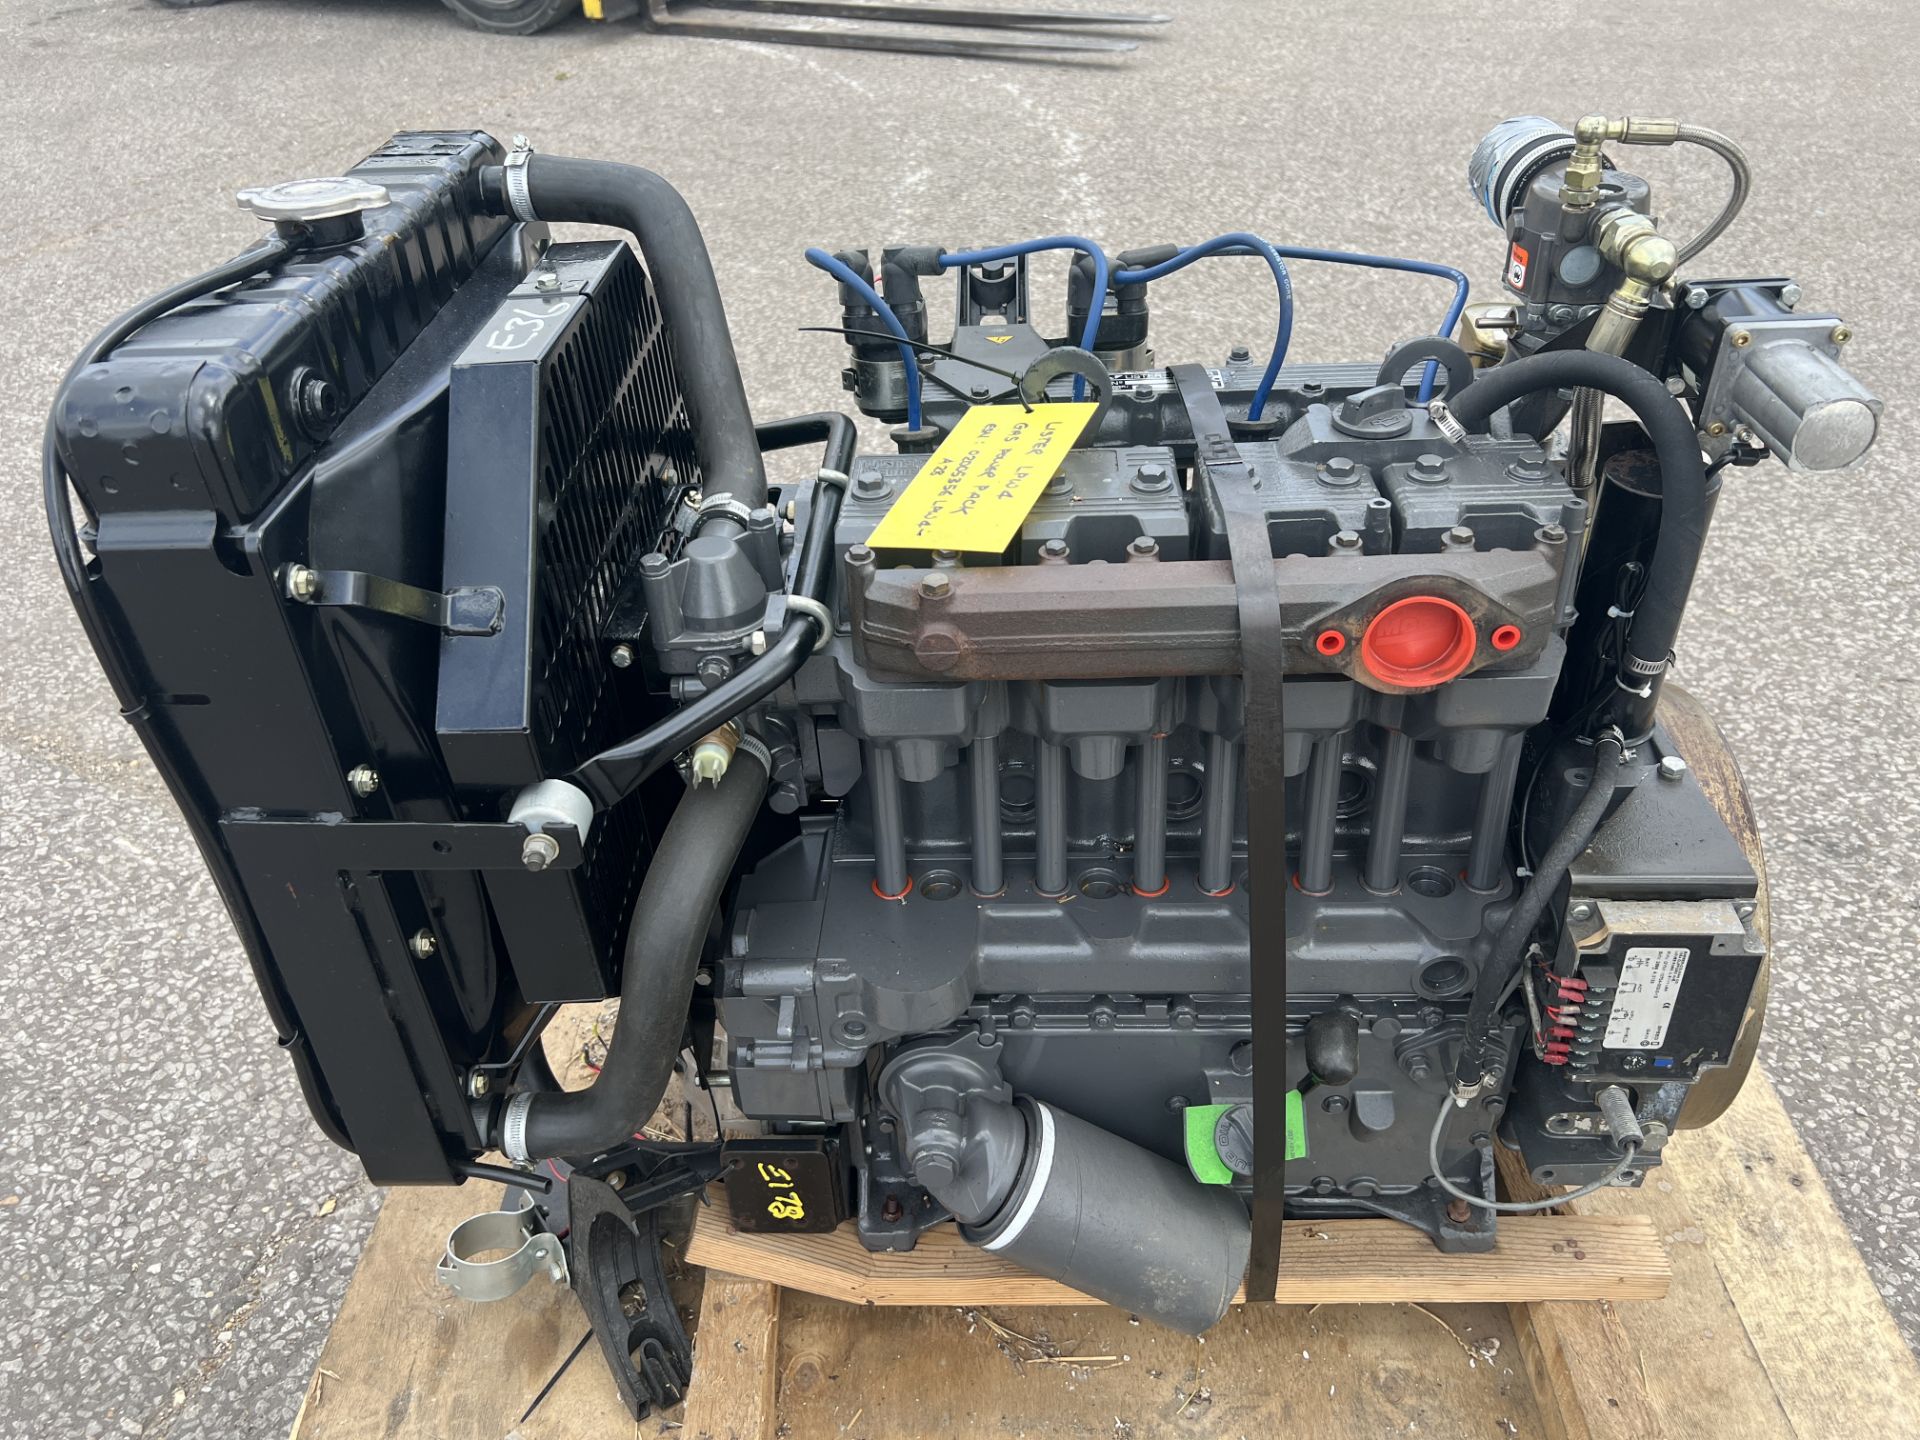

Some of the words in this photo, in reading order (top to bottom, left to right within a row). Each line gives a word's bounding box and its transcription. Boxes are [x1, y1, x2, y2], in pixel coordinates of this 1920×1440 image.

[486, 302, 571, 351] E36
[1004, 422, 1029, 443] GAS
[1030, 422, 1062, 456] LISTER
[949, 485, 986, 515] PACK
[998, 466, 1034, 500] LPW4
